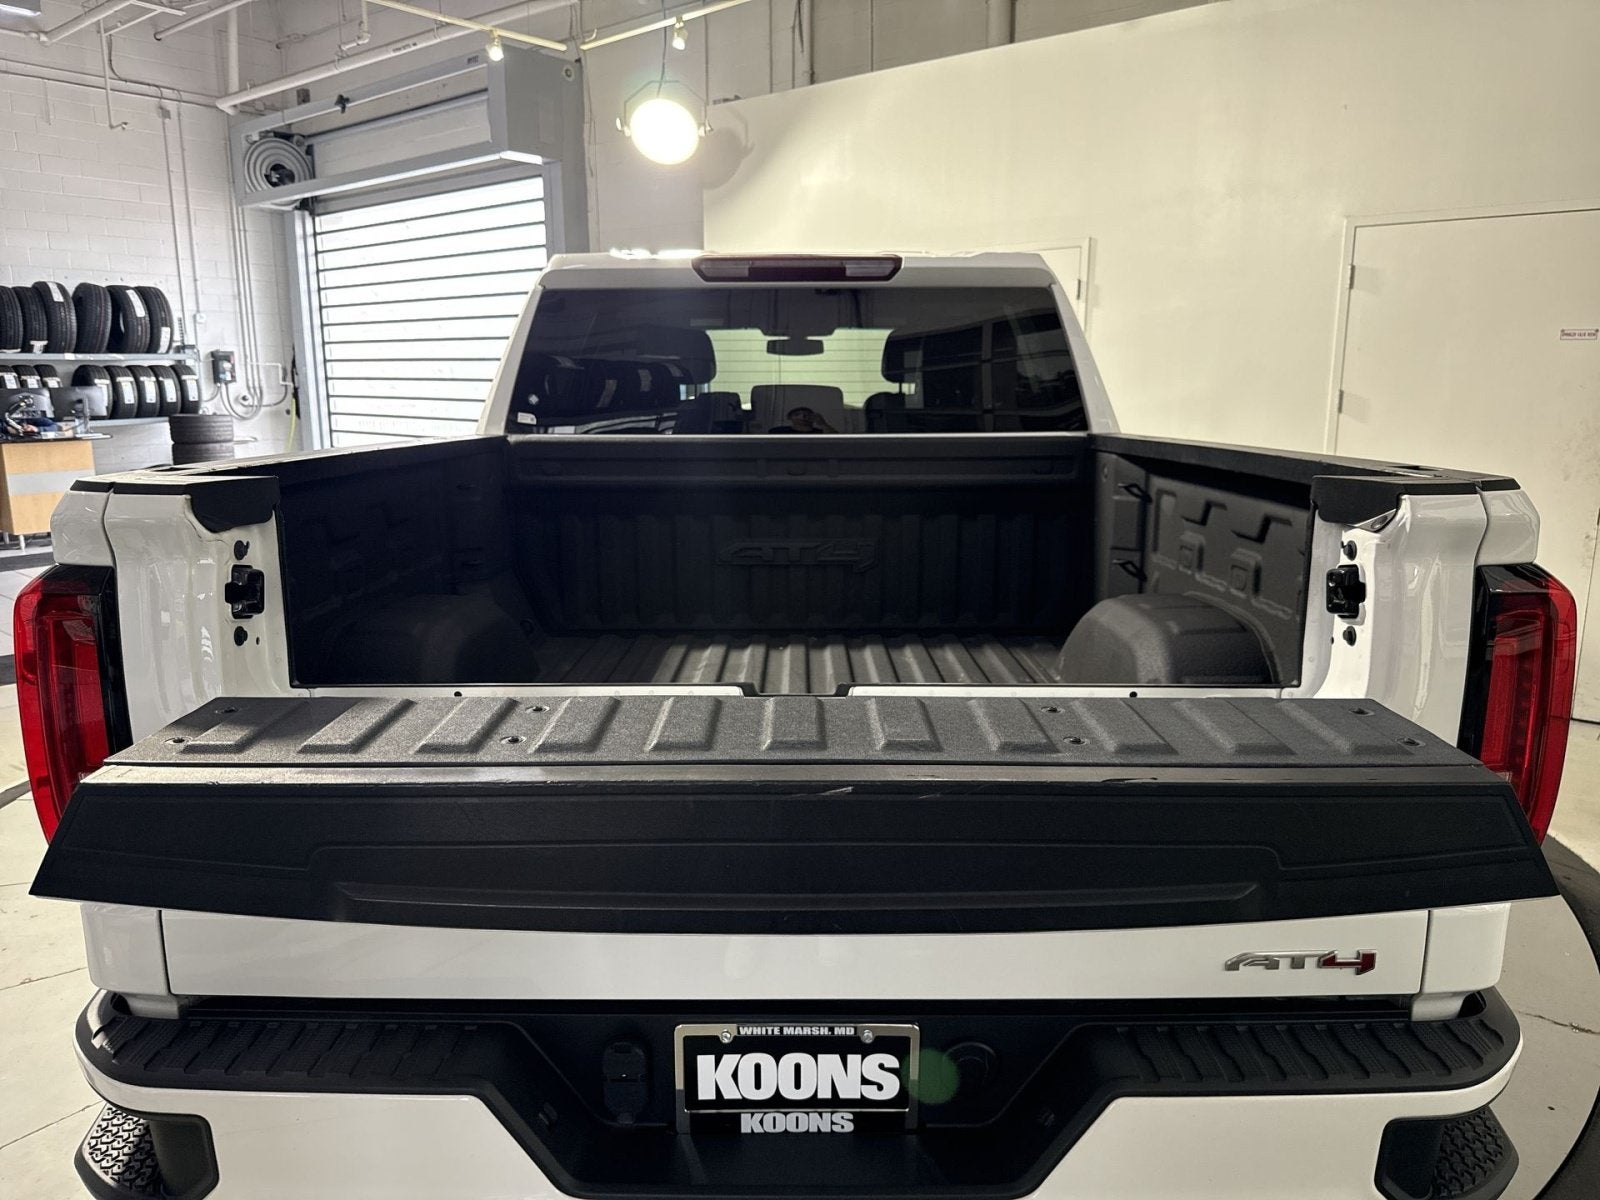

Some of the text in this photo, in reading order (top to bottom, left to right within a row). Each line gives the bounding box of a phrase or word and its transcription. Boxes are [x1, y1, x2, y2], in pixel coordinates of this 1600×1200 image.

[718, 541, 875, 573] AT4
[1224, 949, 1376, 975] AT4
[739, 1026, 780, 1035] WHITE
[834, 1026, 854, 1035] MD
[697, 1053, 900, 1100] KOONS
[741, 1112, 854, 1133] KOONS
